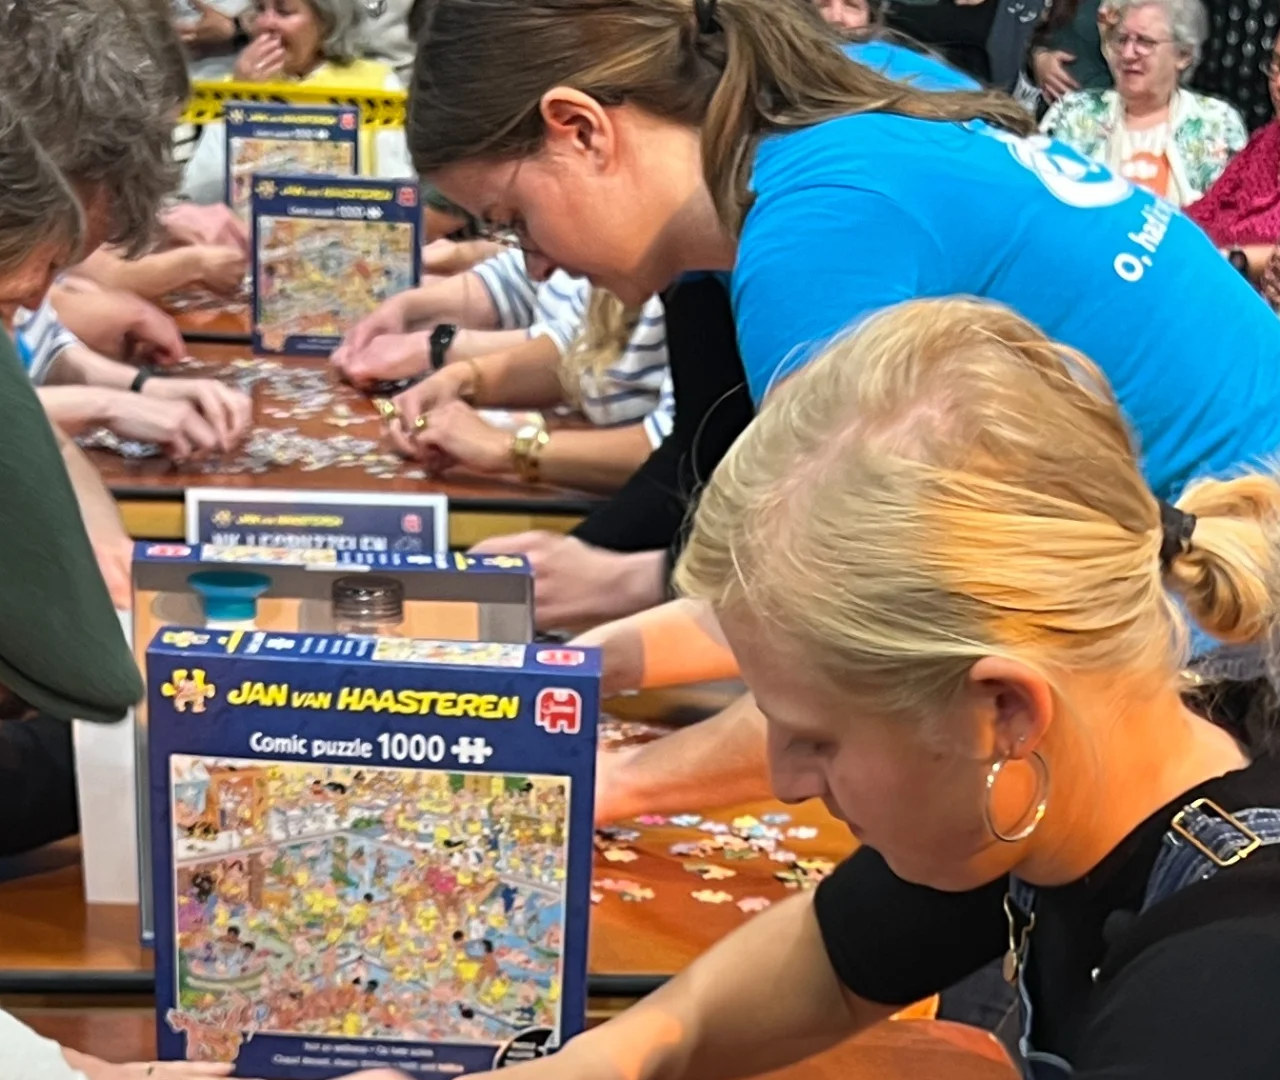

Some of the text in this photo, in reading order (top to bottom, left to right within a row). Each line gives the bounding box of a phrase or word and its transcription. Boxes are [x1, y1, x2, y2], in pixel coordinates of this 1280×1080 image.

[227, 681, 288, 708] JAN
[336, 687, 520, 719] HAASTEREN
[249, 731, 446, 763] Comic puzzle 1000
